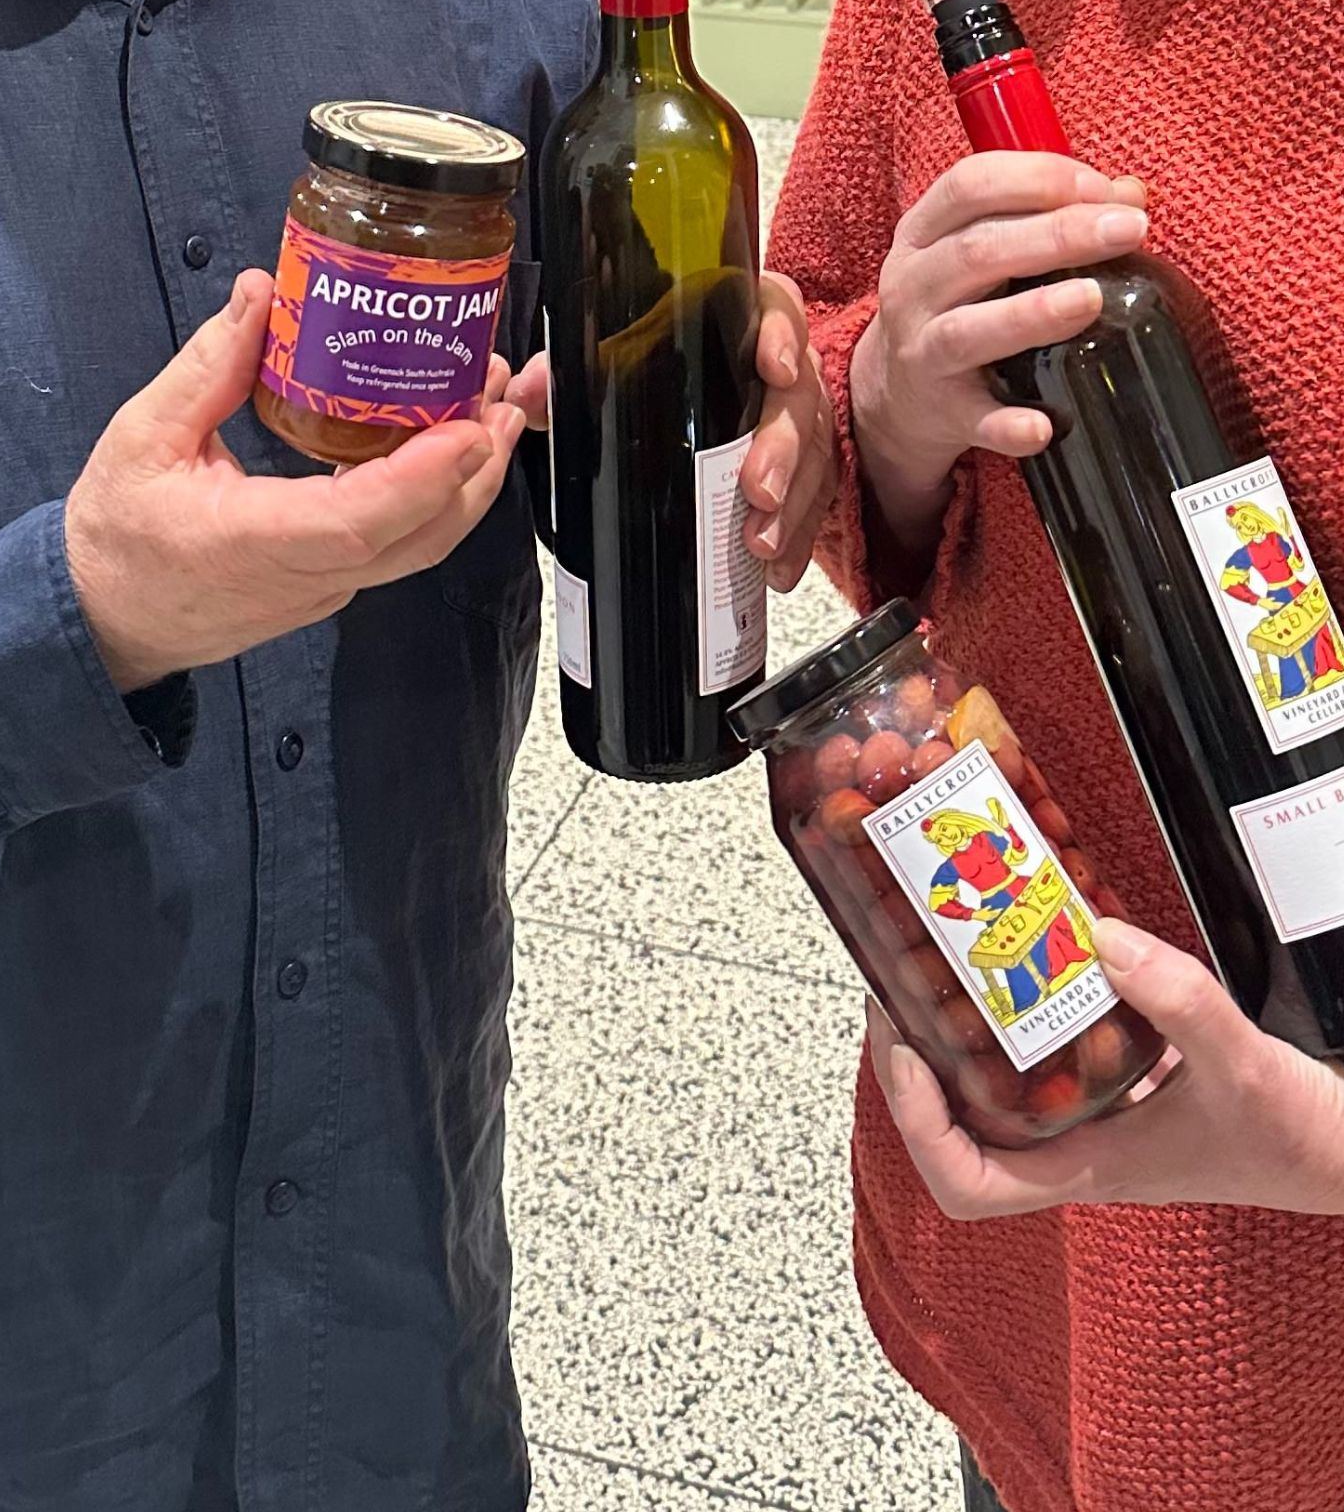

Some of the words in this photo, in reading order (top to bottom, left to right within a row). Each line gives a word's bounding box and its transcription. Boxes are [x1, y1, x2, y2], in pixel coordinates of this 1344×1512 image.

[311, 273, 452, 322] APRICOT
[452, 287, 500, 327] JAM
[325, 329, 376, 356] Slam
[383, 328, 408, 344] on
[414, 327, 443, 349] the
[445, 335, 473, 366] Jam
[342, 359, 360, 370] Made
[361, 363, 369, 372] in
[370, 364, 404, 377] Greenock
[405, 368, 425, 378] South
[347, 374, 364, 386] Keep
[366, 377, 410, 390] refrigerated
[1283, 689, 1341, 721] VINEYARD
[881, 756, 985, 835] BALLYCROFT
[1263, 797, 1327, 830] SMALL
[1019, 985, 1083, 1034] VINEYARD
[1086, 971, 1103, 986] AN
[1048, 987, 1101, 1031] CELLARS
